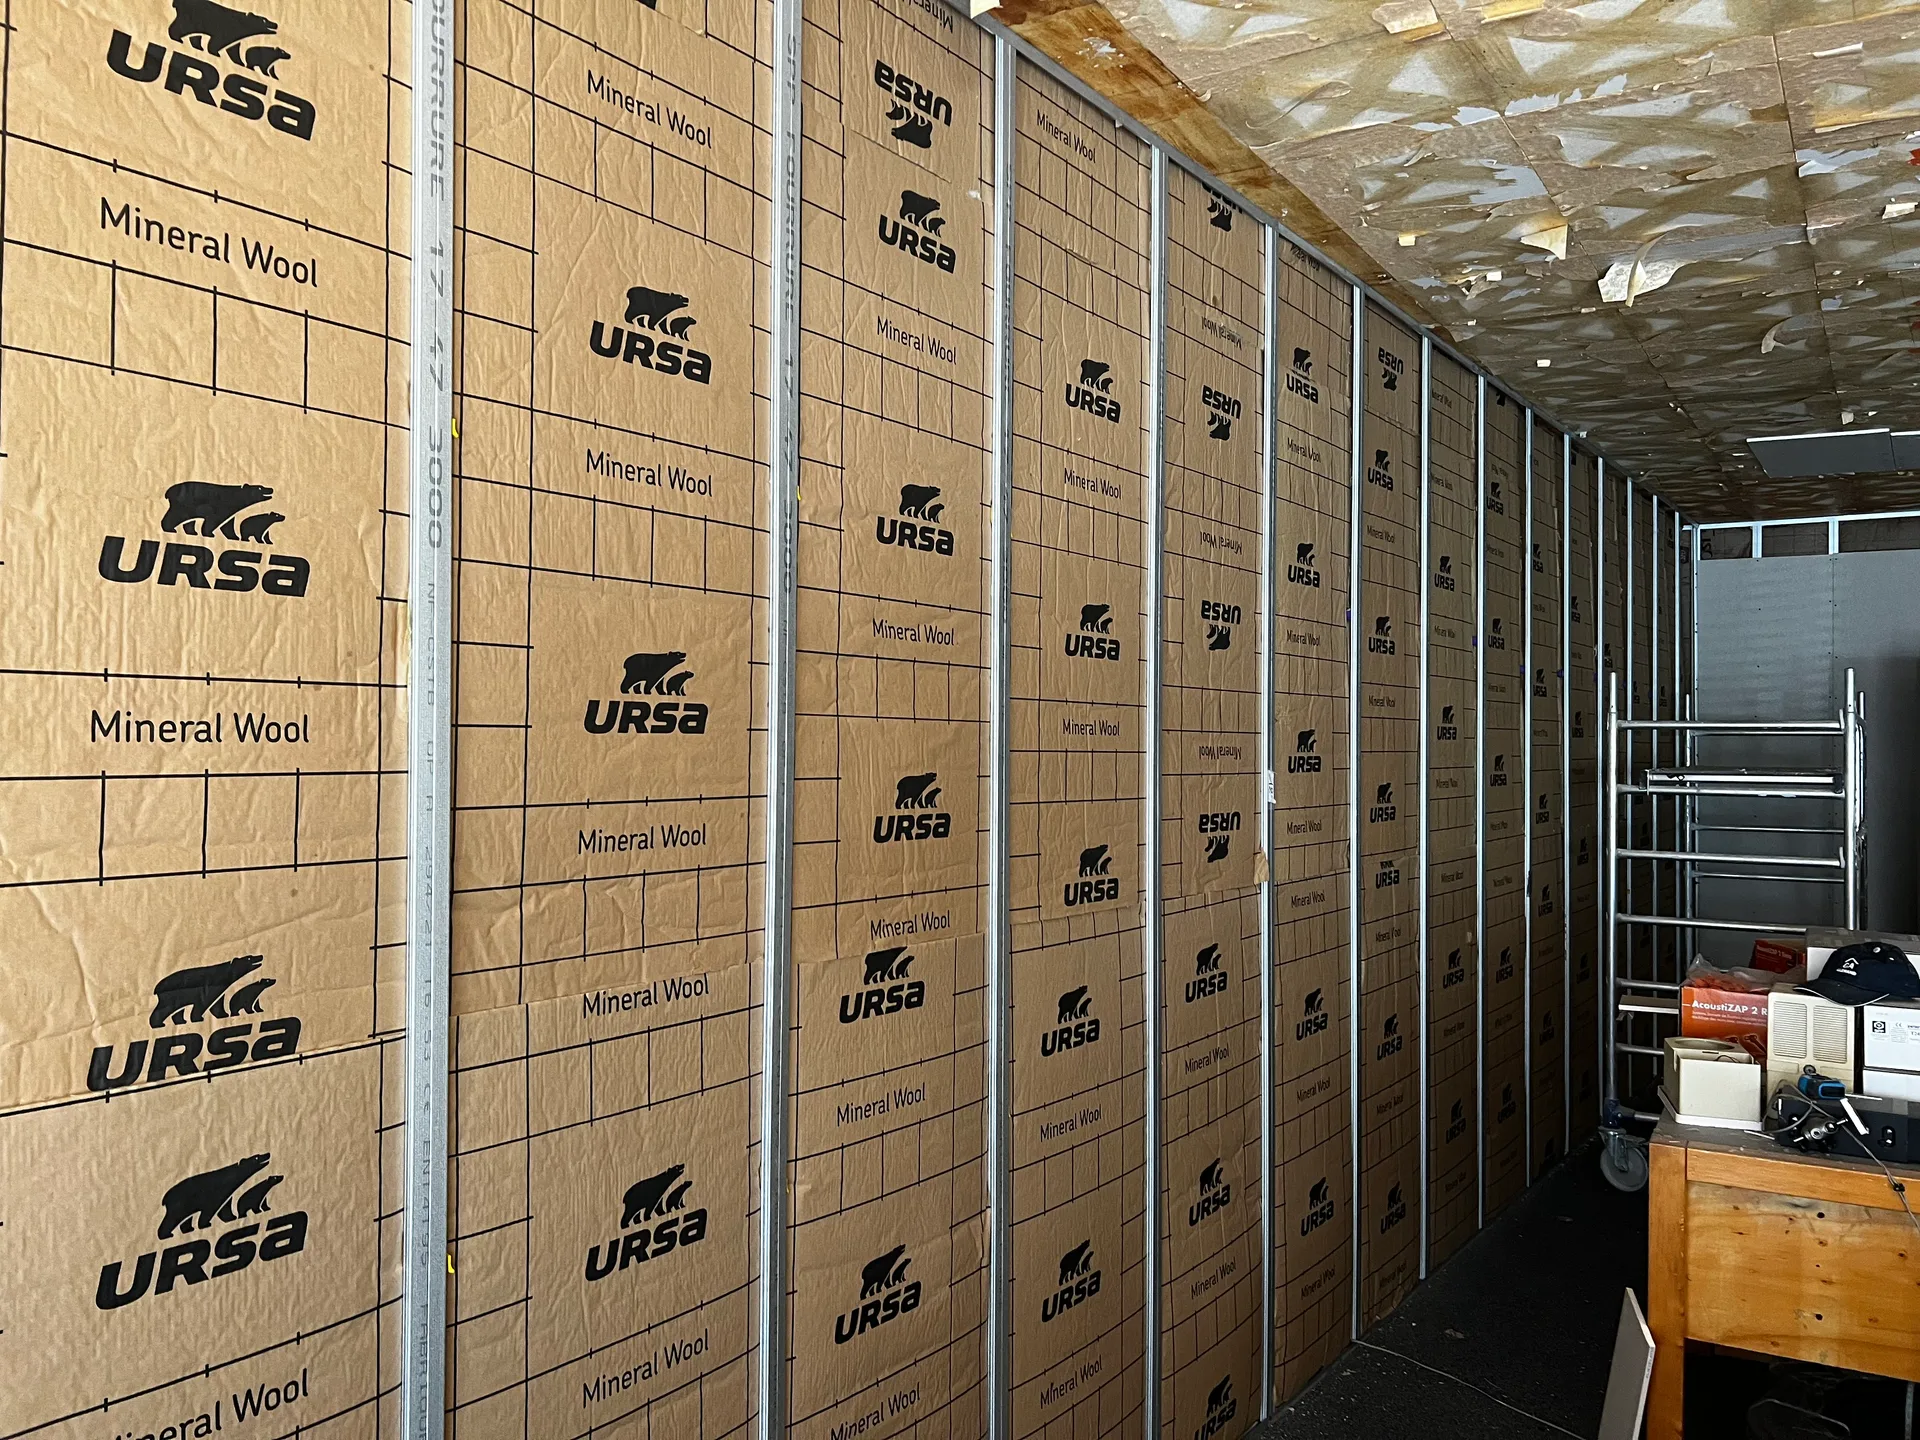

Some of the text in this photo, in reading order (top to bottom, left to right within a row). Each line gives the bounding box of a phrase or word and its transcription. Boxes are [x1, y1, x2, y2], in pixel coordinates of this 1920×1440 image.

[587, 69, 711, 148] Mineral Wool
[1037, 109, 1096, 163] Mineral Wool
[100, 197, 317, 287] Mineral Wool
[430, 240, 445, 298] 17
[878, 316, 956, 365] Mineral Wool
[429, 425, 444, 549] 3000
[587, 449, 712, 496] Mineral Wool
[1064, 468, 1121, 499] Mineral Wool
[873, 618, 954, 645] Mineral Wool
[92, 710, 308, 742] Mineral Wool
[1063, 718, 1119, 736] Mineral Wool
[579, 823, 706, 854] Mineral Wool
[871, 910, 950, 940] Mineral Wool
[584, 973, 708, 1018] Mineral Wool
[1752, 1007, 1758, 1015] 2
[1185, 1043, 1229, 1074] Mineral Wool
[838, 1082, 925, 1126] Mineral Wool
[1041, 1104, 1101, 1142] Mineral Wool
[1191, 1257, 1236, 1299] Mineral Wool
[583, 1328, 708, 1408] Mineral Wool
[1041, 1355, 1102, 1409] Mineral Wool
[233, 1368, 308, 1422] Wool
[831, 1382, 920, 1440] Mineral Wool
